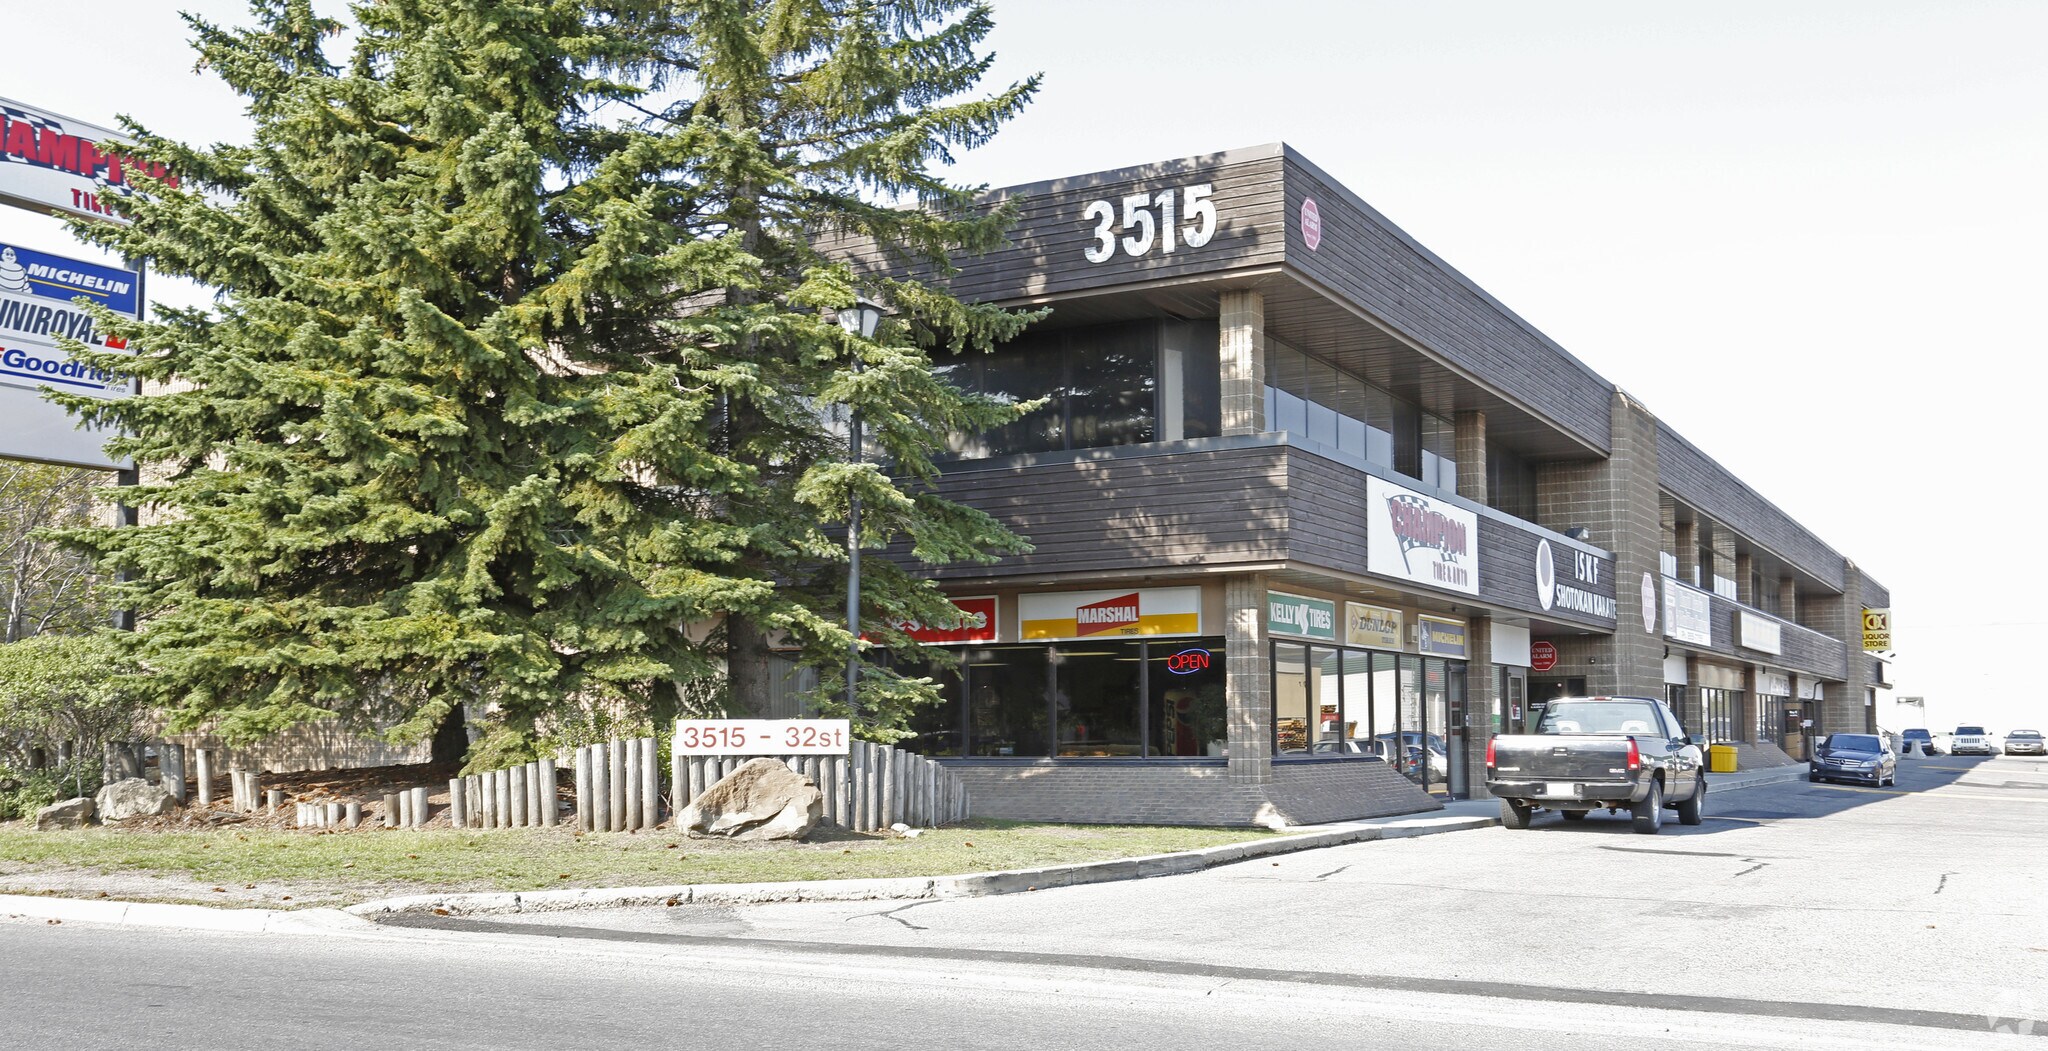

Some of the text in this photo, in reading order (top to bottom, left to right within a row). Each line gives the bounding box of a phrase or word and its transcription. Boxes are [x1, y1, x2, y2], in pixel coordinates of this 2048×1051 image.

[1084, 183, 1217, 263] 3515
[27, 263, 130, 295] MICHELIN
[1391, 499, 1467, 557] CHAMPION
[1433, 560, 1447, 582] TIRE
[1556, 583, 1594, 614] SHOTOKAN
[1593, 593, 1617, 620] KARATE
[1077, 606, 1139, 624] MARSHAL
[1270, 602, 1296, 625] KELLY
[1309, 608, 1331, 630] TIRES
[1359, 616, 1397, 634] DUNLOP
[1120, 627, 1139, 635] TIRES
[1432, 630, 1464, 646] MICHELIN
[1168, 653, 1210, 669] OPEN
[684, 727, 746, 748] 3515
[785, 726, 842, 747] 32st
